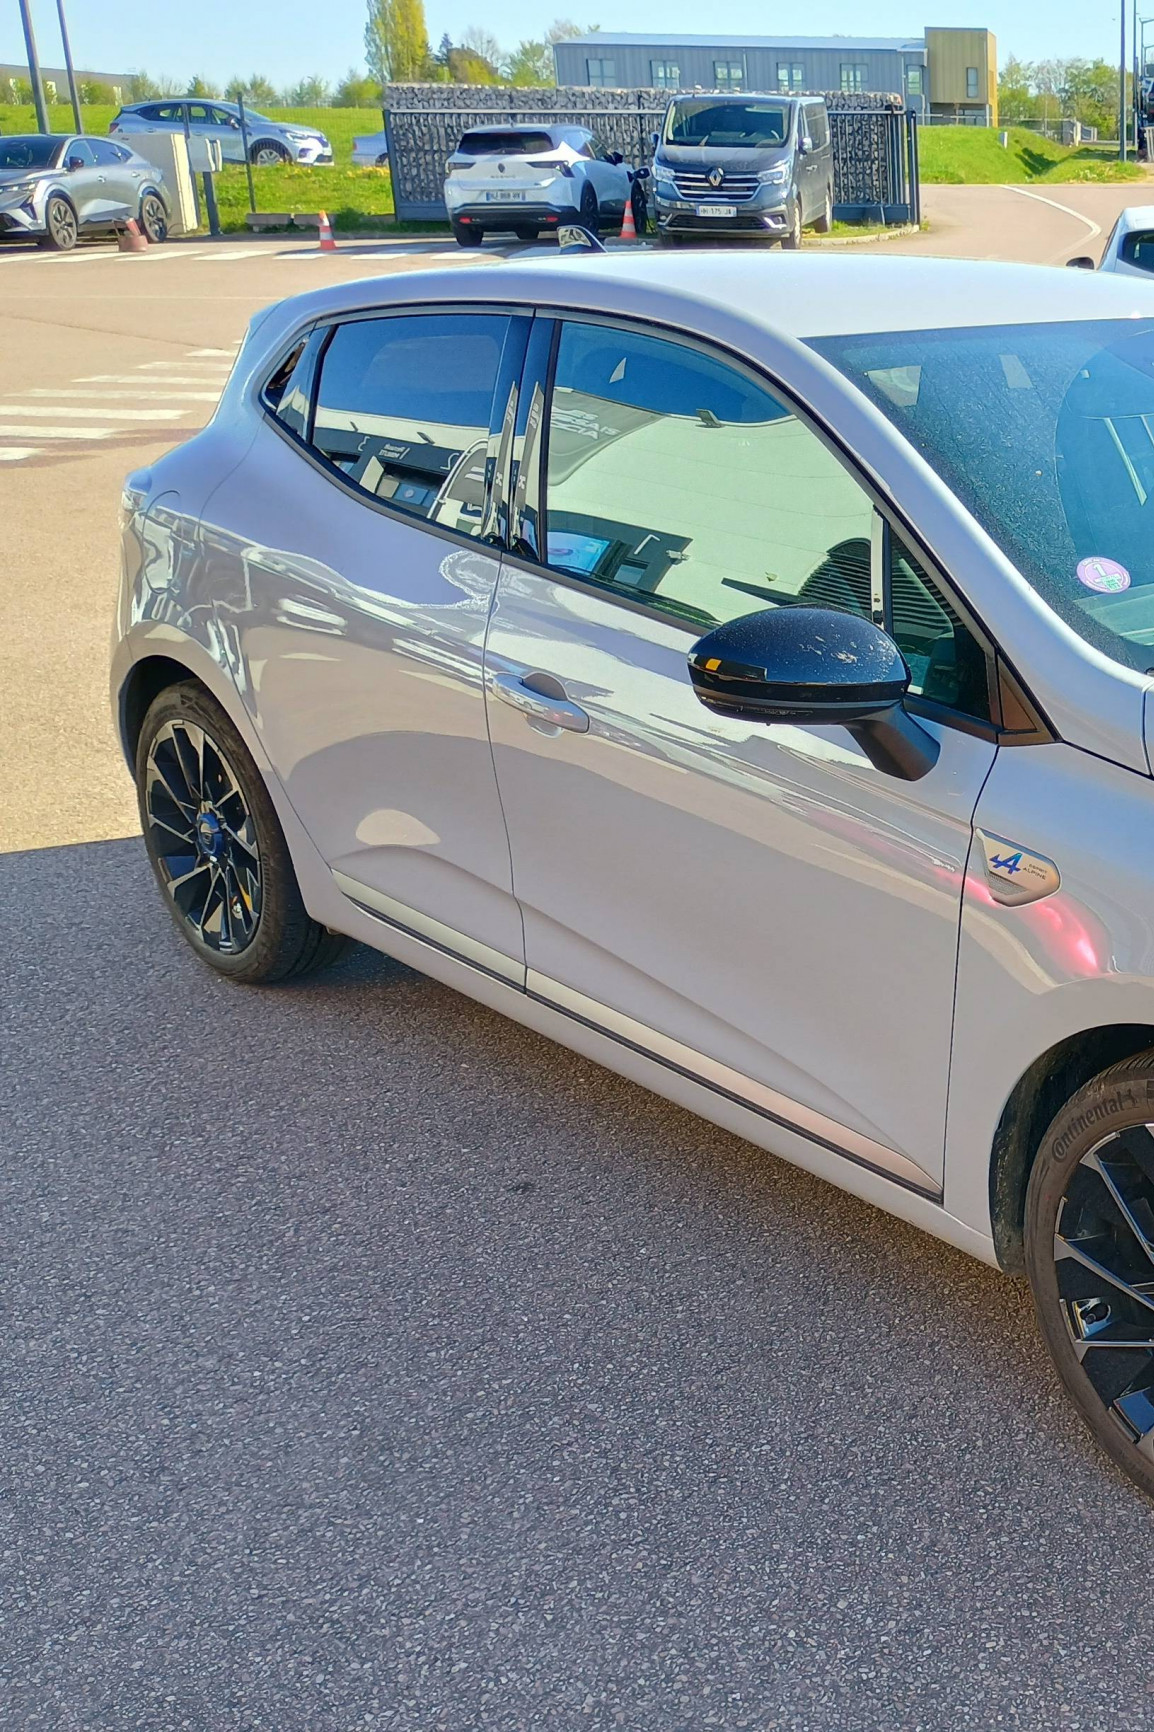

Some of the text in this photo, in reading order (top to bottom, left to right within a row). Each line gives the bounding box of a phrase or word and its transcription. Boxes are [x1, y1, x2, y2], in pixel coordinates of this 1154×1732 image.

[1093, 563, 1107, 577] 1
[1022, 867, 1046, 880] ALPINE
[1051, 1090, 1125, 1162] Continental
